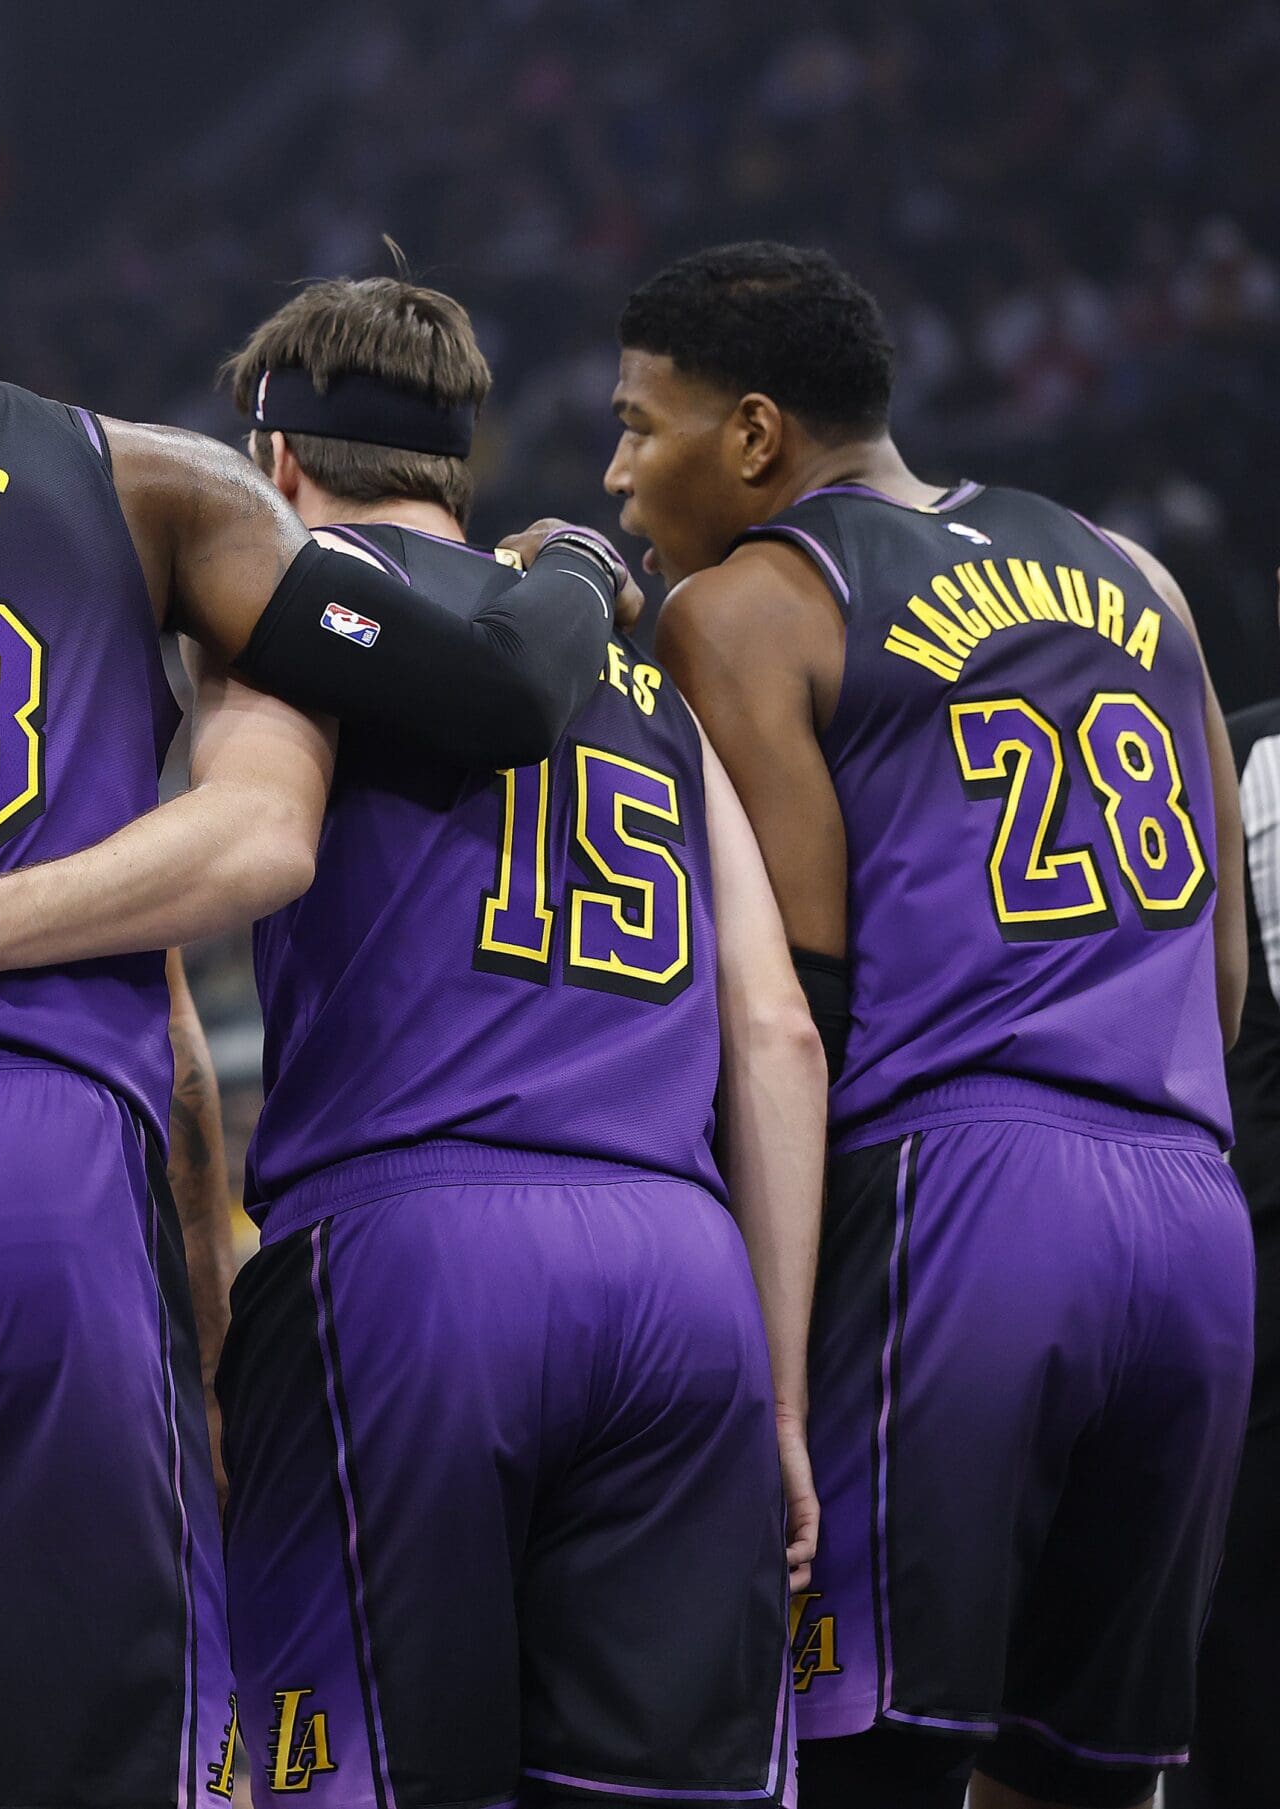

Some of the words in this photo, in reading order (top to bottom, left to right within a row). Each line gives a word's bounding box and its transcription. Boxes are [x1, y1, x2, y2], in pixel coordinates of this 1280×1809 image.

[599, 641, 662, 716] ES
[882, 558, 1162, 683] HACHIMURA
[478, 745, 689, 984] 15
[949, 693, 1206, 923] 28
[265, 1689, 335, 1790] LA
